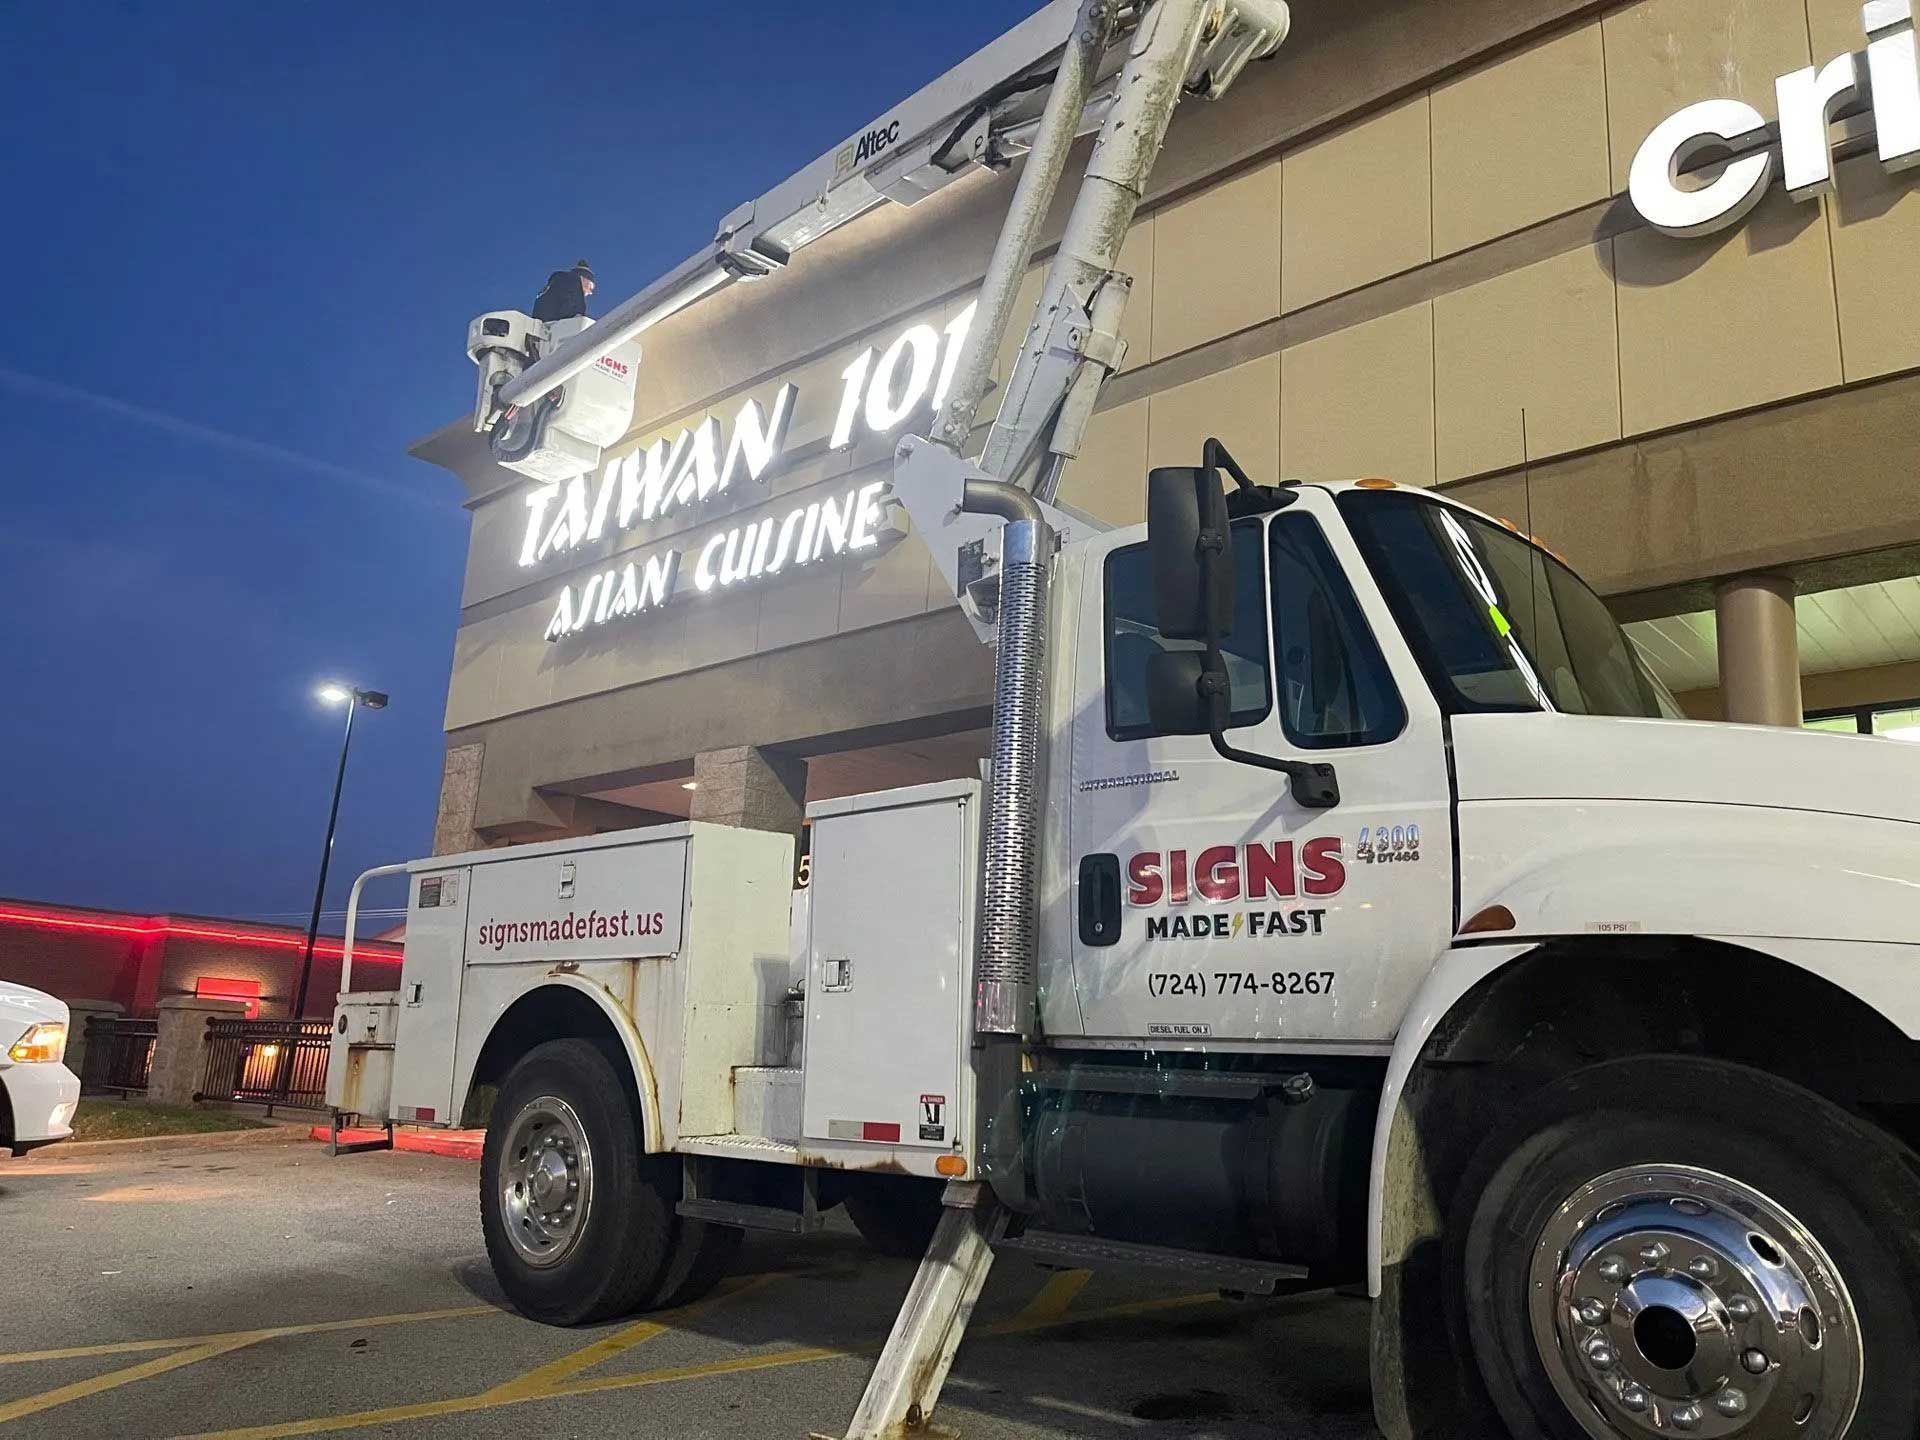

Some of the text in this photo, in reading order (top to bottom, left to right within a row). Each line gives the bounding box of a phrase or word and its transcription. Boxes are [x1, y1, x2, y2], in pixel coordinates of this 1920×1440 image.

[1629, 0, 1920, 230] cri
[853, 120, 900, 167] Altec
[597, 355, 628, 375] IGNS
[518, 298, 978, 567] TAIWAN 101
[545, 480, 889, 641] ASIAN CUISINE
[1080, 769, 1180, 792] INTERNATIONAL
[1357, 824, 1420, 861] 4300
[1127, 836, 1347, 907] SIGNS
[479, 909, 664, 951] signsmadefast.us
[1146, 908, 1326, 941] MADE FAST
[1613, 923, 1628, 932] PSI
[1148, 971, 1335, 997] (724) 774-8267
[1150, 1025, 1172, 1034] DIESEL
[1173, 1025, 1191, 1034] FUEL
